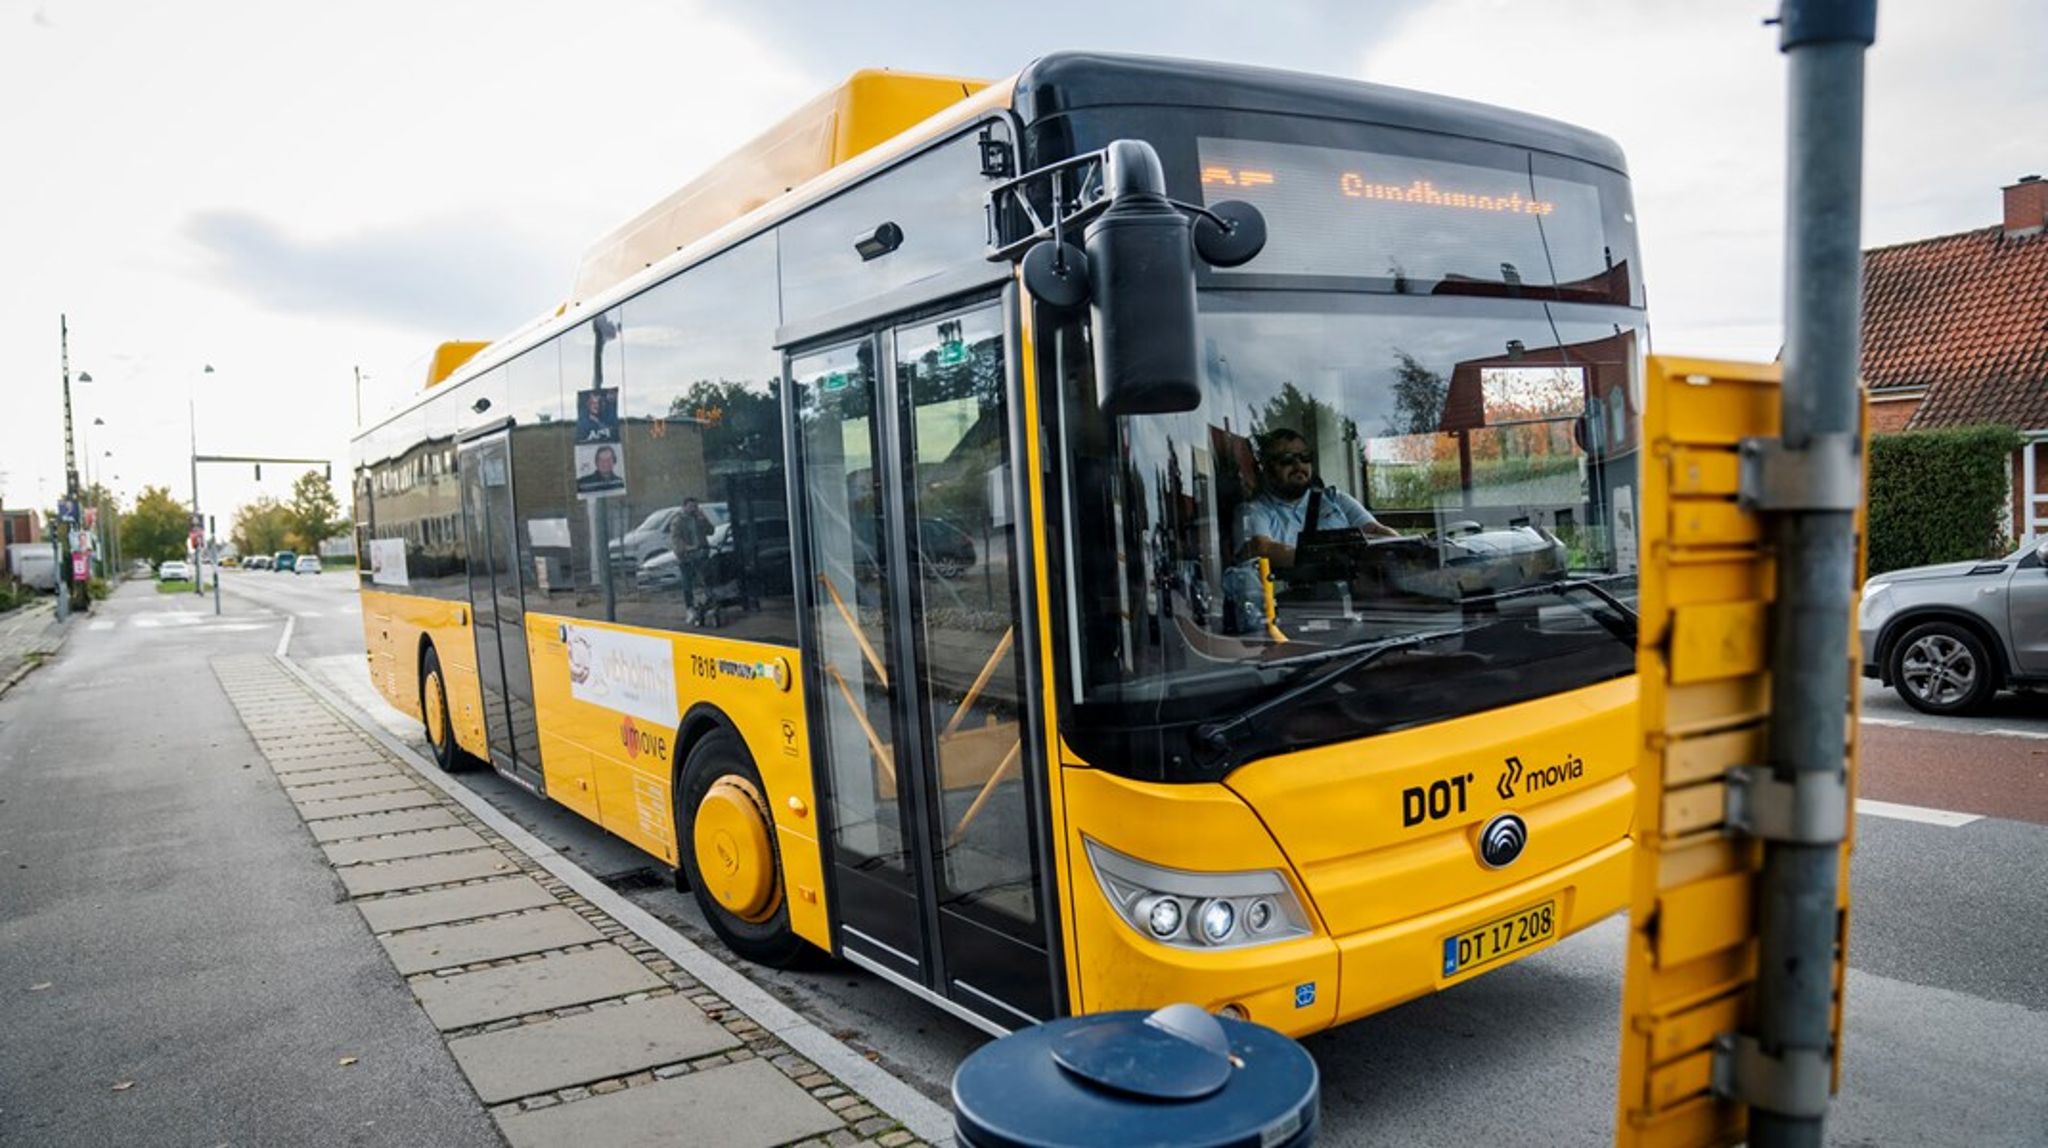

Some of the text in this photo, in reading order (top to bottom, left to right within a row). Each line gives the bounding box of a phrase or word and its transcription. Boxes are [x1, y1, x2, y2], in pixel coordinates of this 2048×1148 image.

[690, 654, 716, 679] 7818
[1526, 754, 1583, 793] movia
[1402, 773, 1473, 828] DOT
[1459, 907, 1551, 966] DT 17 208
